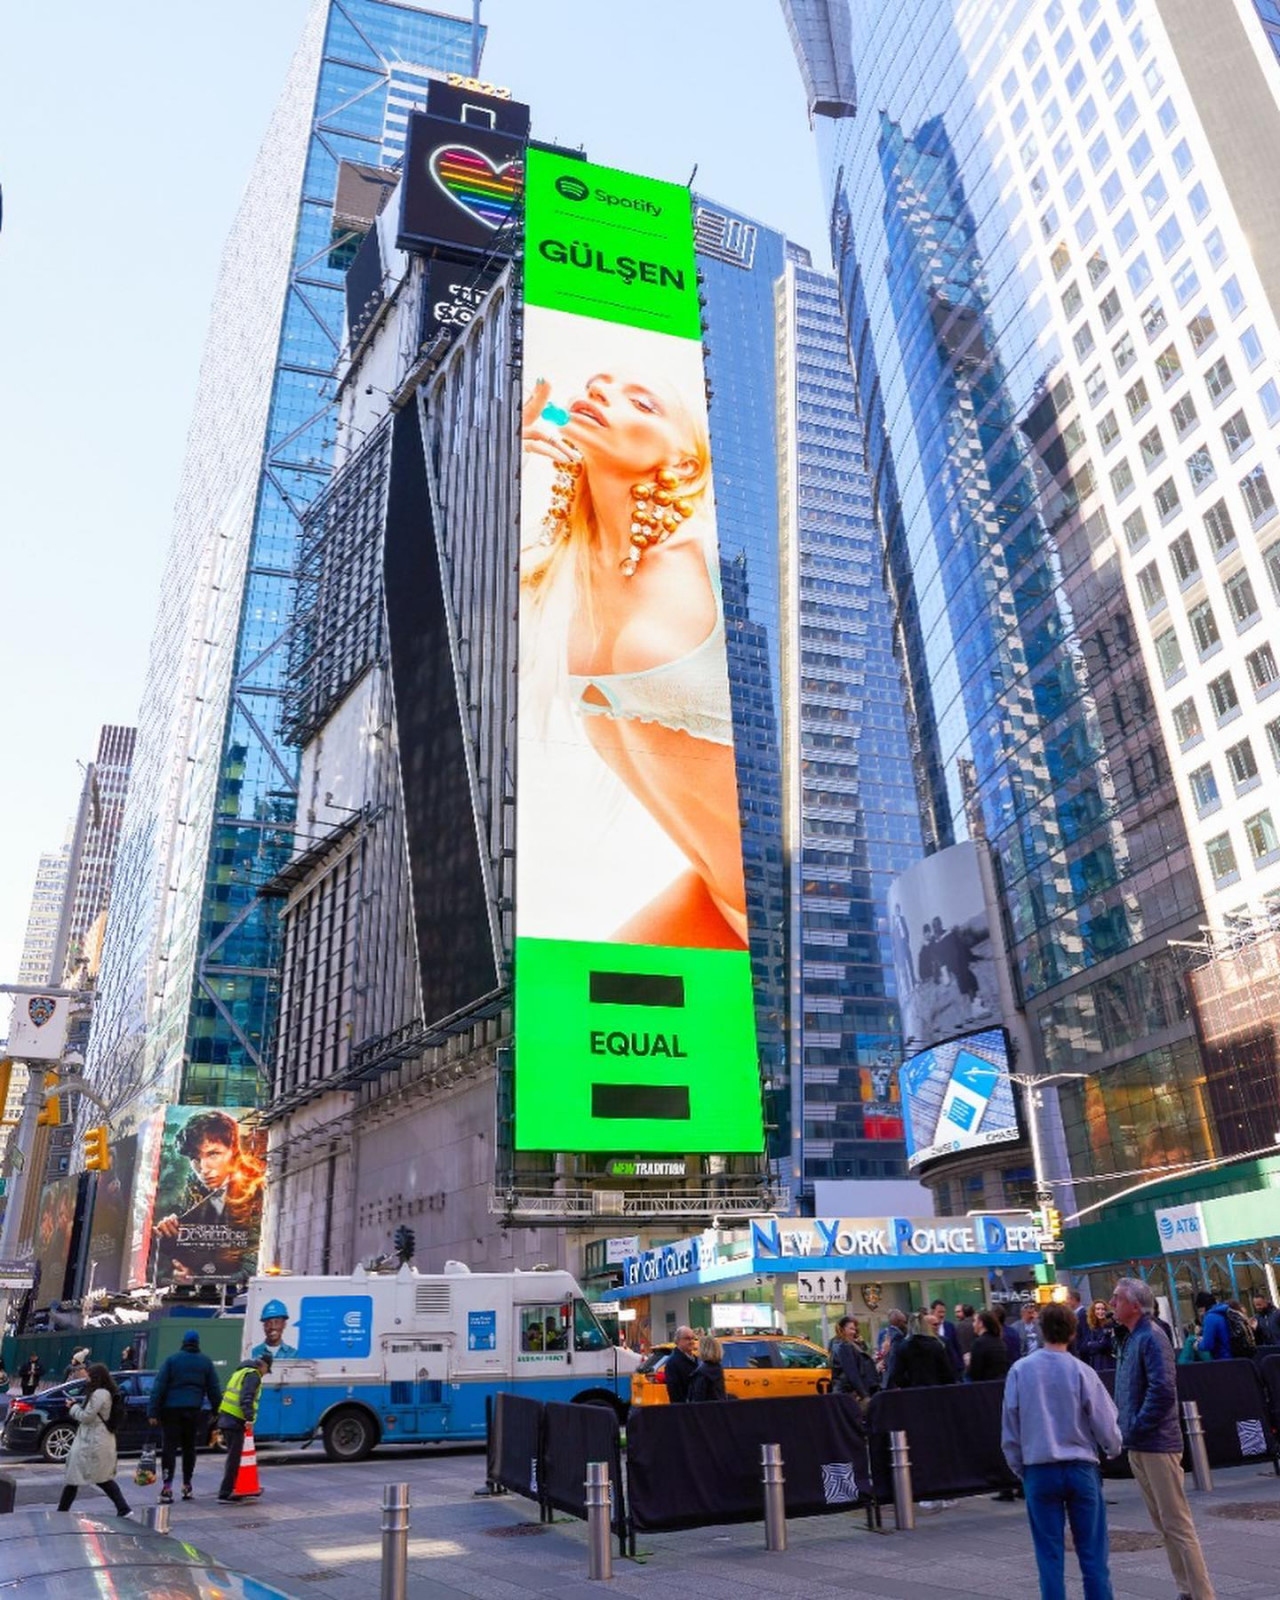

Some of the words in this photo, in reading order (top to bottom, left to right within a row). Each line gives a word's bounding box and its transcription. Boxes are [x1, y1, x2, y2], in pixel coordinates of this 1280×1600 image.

[595, 189, 662, 217] Spotify
[538, 239, 685, 291] GÜLŞEN
[590, 1031, 688, 1058] EQUAL
[750, 1219, 813, 1258] NEW
[815, 1219, 888, 1257] YORK
[890, 1216, 975, 1256] POLICE
